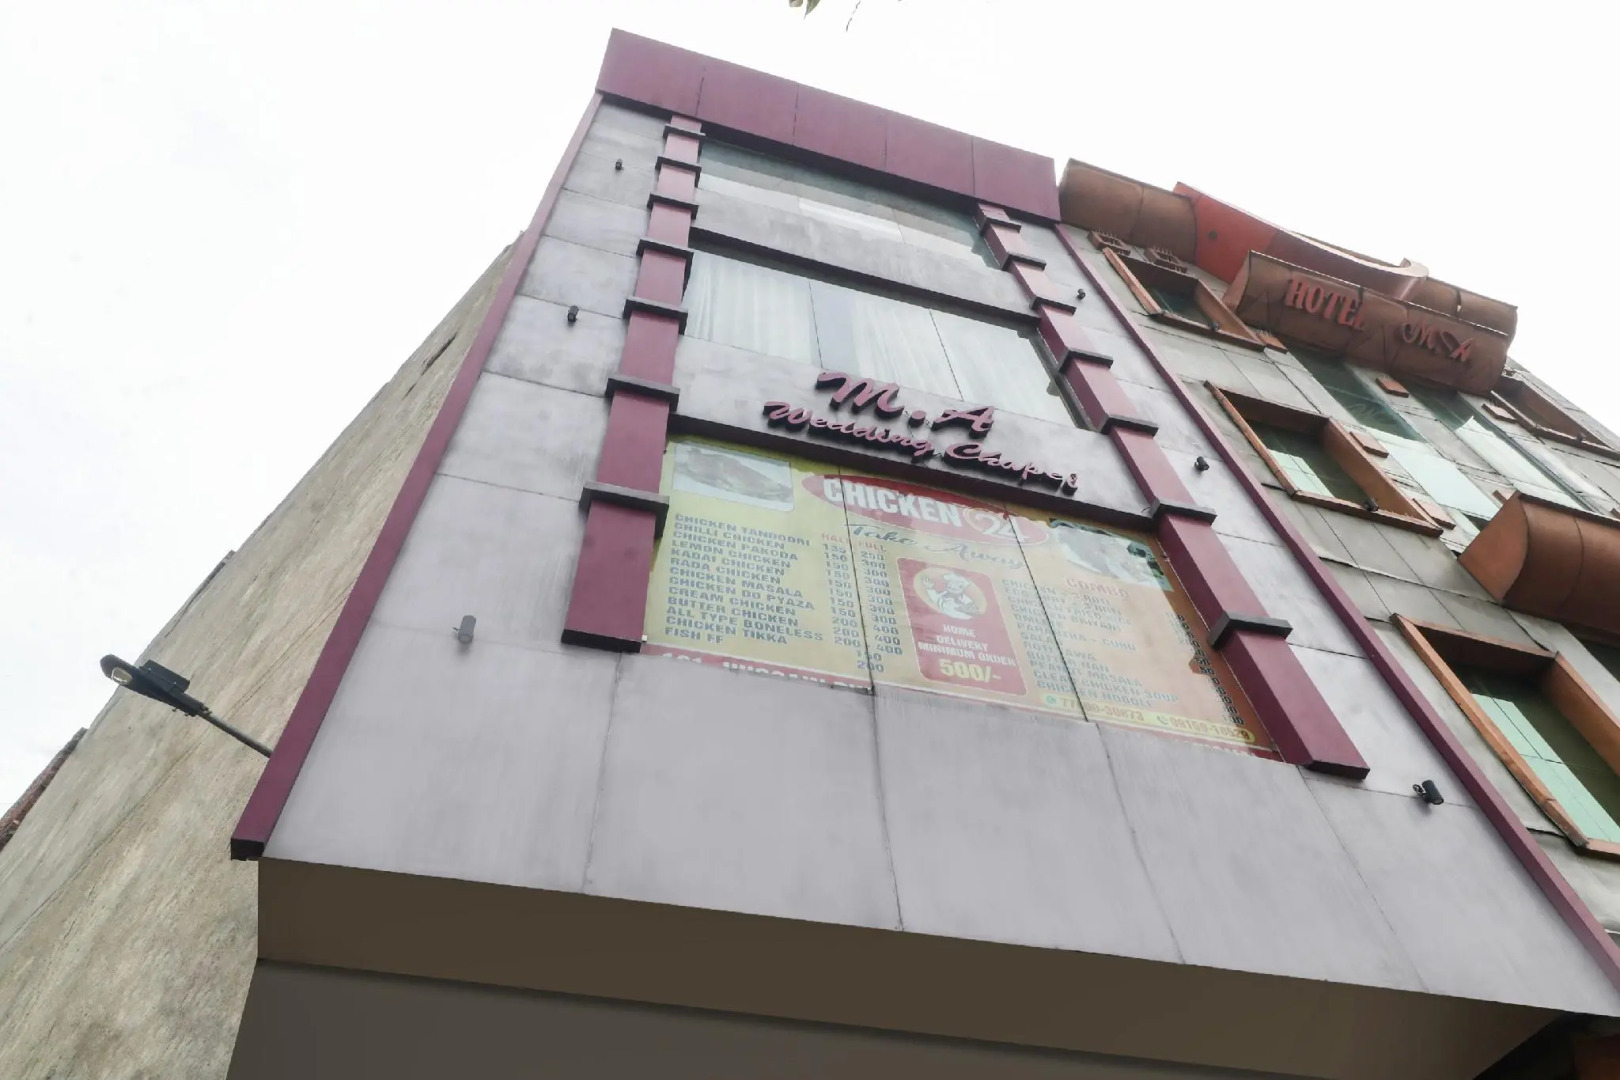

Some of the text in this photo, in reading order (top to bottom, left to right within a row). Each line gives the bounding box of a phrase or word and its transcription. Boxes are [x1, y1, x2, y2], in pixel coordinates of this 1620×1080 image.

[1284, 275, 1364, 330] HOTEL
[764, 401, 1079, 495] Wedding Chapel
[824, 478, 962, 527] CHICKEN
[674, 522, 885, 568] CHILLI CHICKEN 150 300
[675, 514, 735, 531] CHICKEN
[742, 527, 809, 545] TANDOORI
[844, 523, 1024, 569] Take Away
[858, 540, 885, 551] FULL
[671, 548, 890, 595] KADAI CHICKEN 150 300
[672, 539, 889, 586] LEMON CHICKEN 150 300
[673, 531, 887, 577] CHICKEN PAKODA 150 300
[669, 566, 894, 614] CHICKEN MASALA 150 300
[669, 576, 896, 624] CHICKEN DO PYAZA 150 300
[670, 557, 892, 605] RADA CHICKEN 150 300
[1002, 579, 1055, 594] CHICEN
[665, 626, 699, 639] FISH
[666, 615, 735, 634] CHICKEN
[743, 629, 786, 644] TIKKA
[667, 605, 903, 656] ALL TYPE BONELESS 200 400
[668, 596, 901, 645] BUTTER CHICKEN 200 400
[669, 586, 899, 635] CREAM CHICKEN 200 400
[943, 624, 976, 637] HOME
[918, 642, 1016, 667] MINIMUM ORDER
[936, 635, 988, 652] DELIVERY
[1057, 648, 1095, 660] AWA
[940, 659, 1002, 683] 500/-
